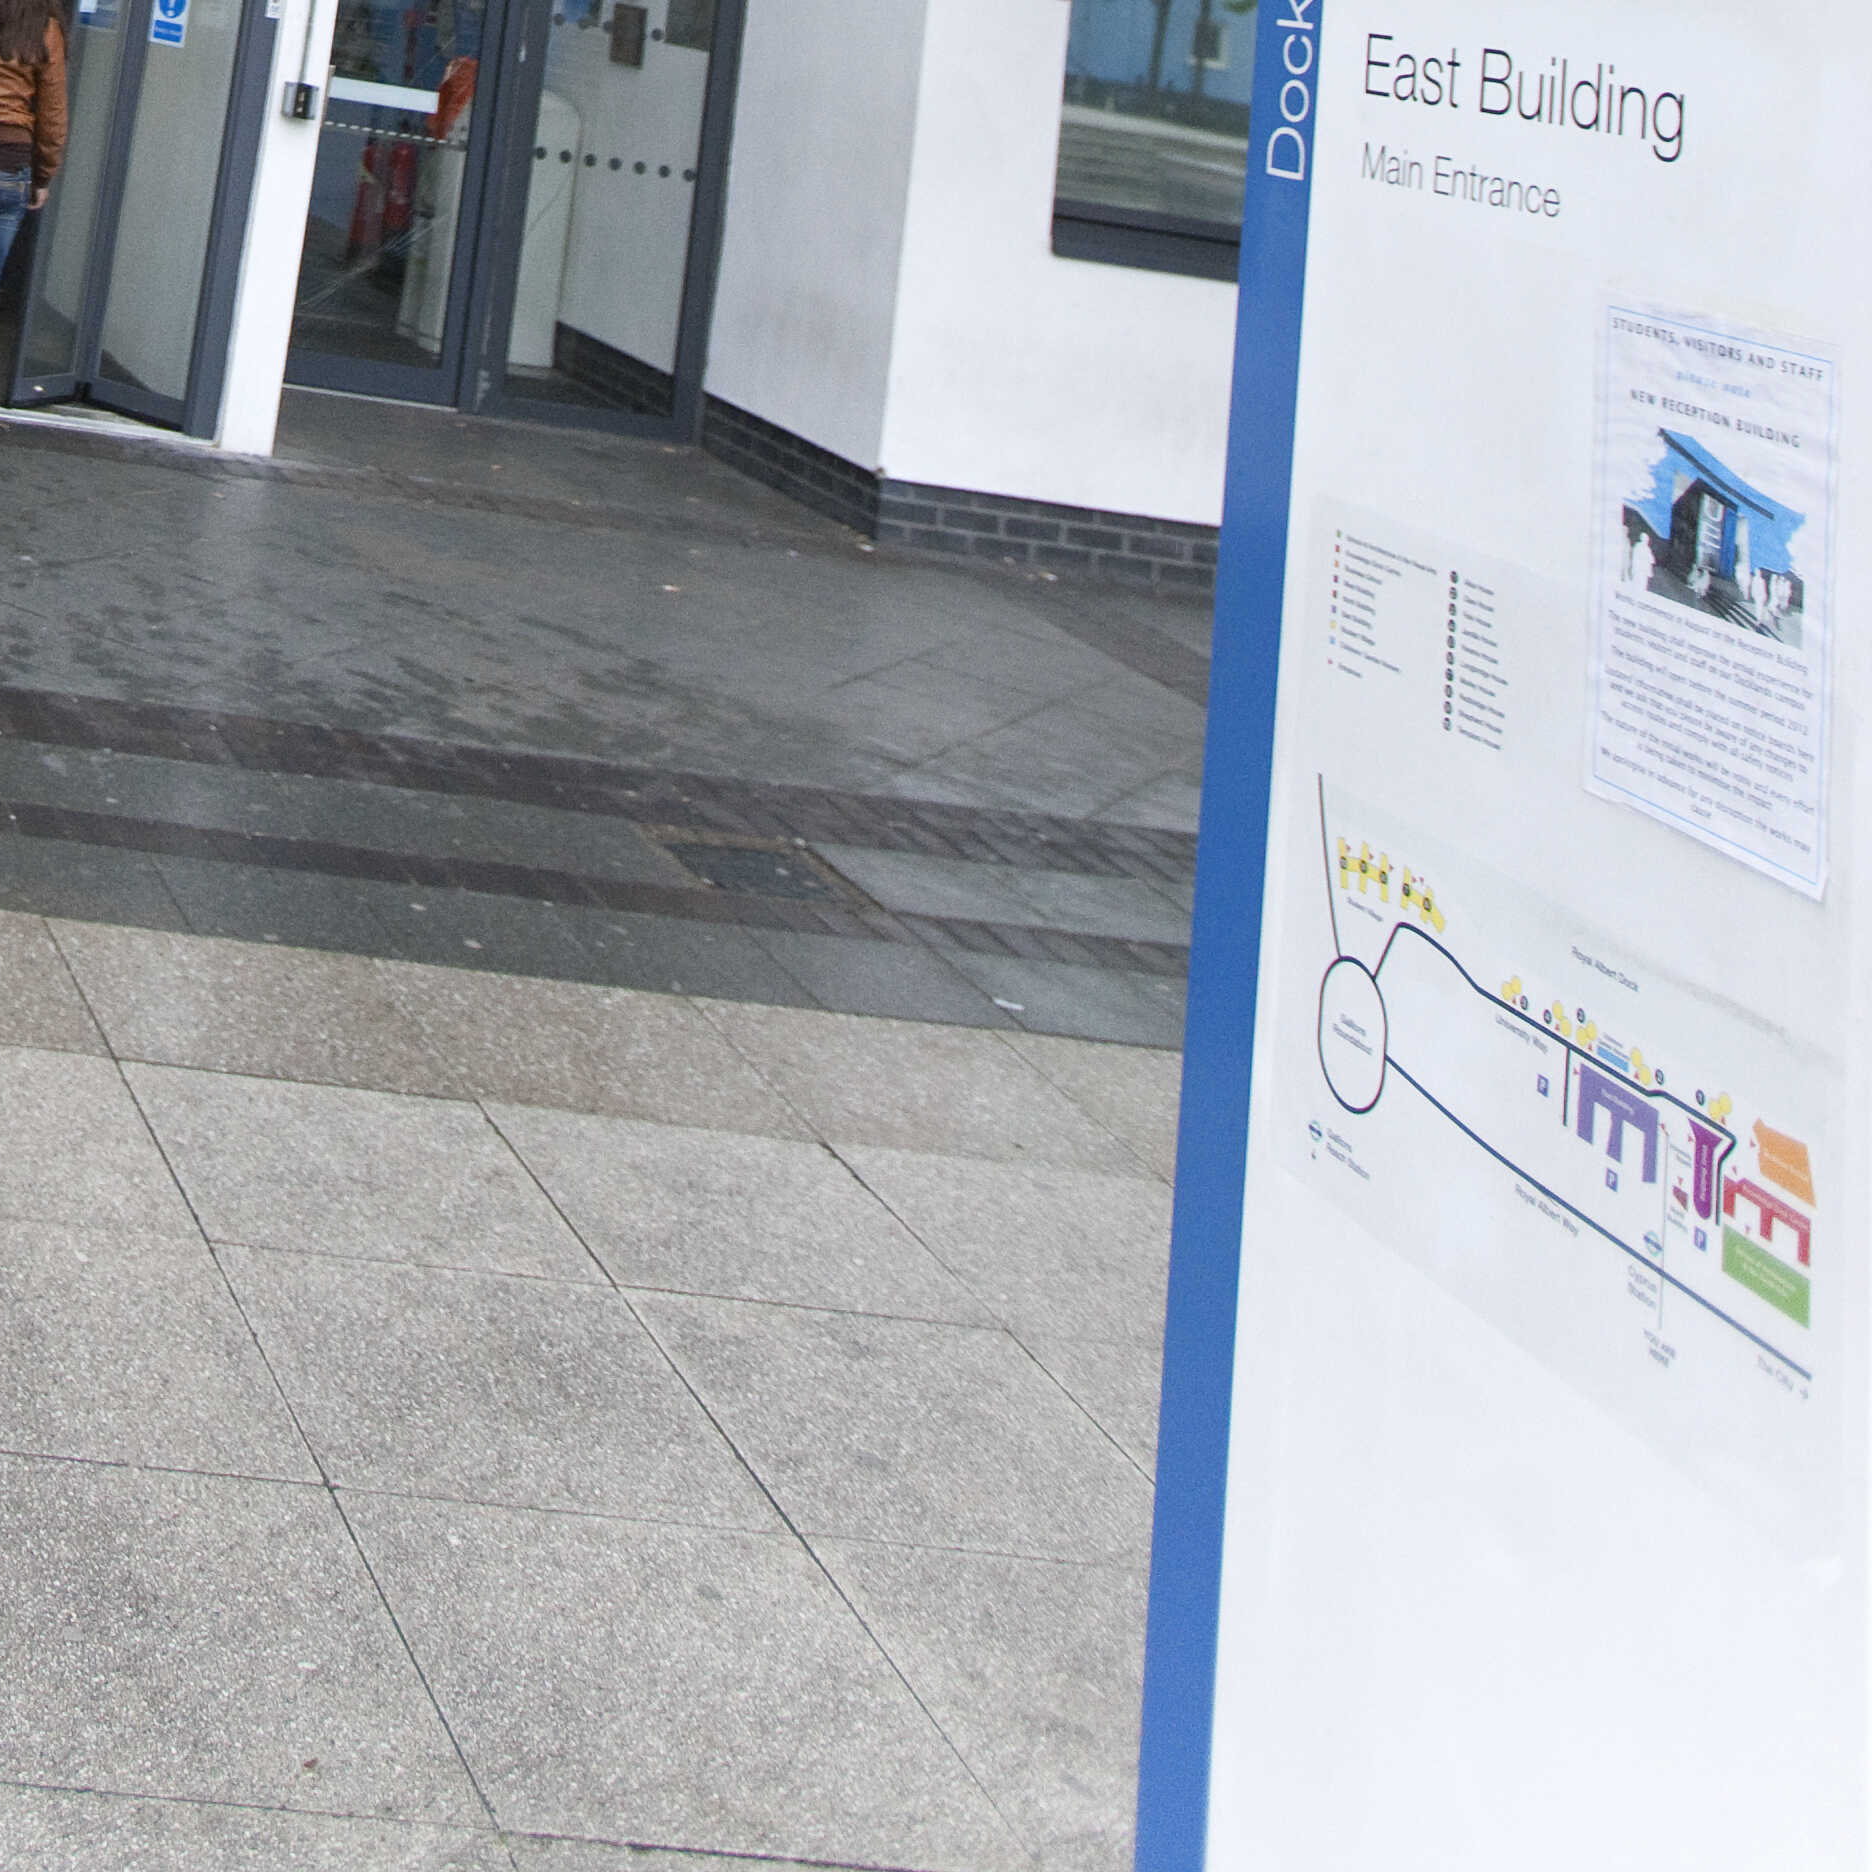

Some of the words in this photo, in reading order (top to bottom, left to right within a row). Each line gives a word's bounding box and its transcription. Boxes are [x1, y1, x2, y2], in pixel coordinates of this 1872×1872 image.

[1364, 32, 1462, 109] East
[1479, 48, 1685, 162] Building
[1361, 142, 1423, 192] Main
[1432, 155, 1561, 218] Entrance
[1747, 353, 1775, 370] AND
[1780, 359, 1823, 382] STAFF
[1630, 388, 1656, 407] NEW
[1661, 396, 1732, 430] RECEPTION
[1736, 418, 1801, 448] BUILDING
